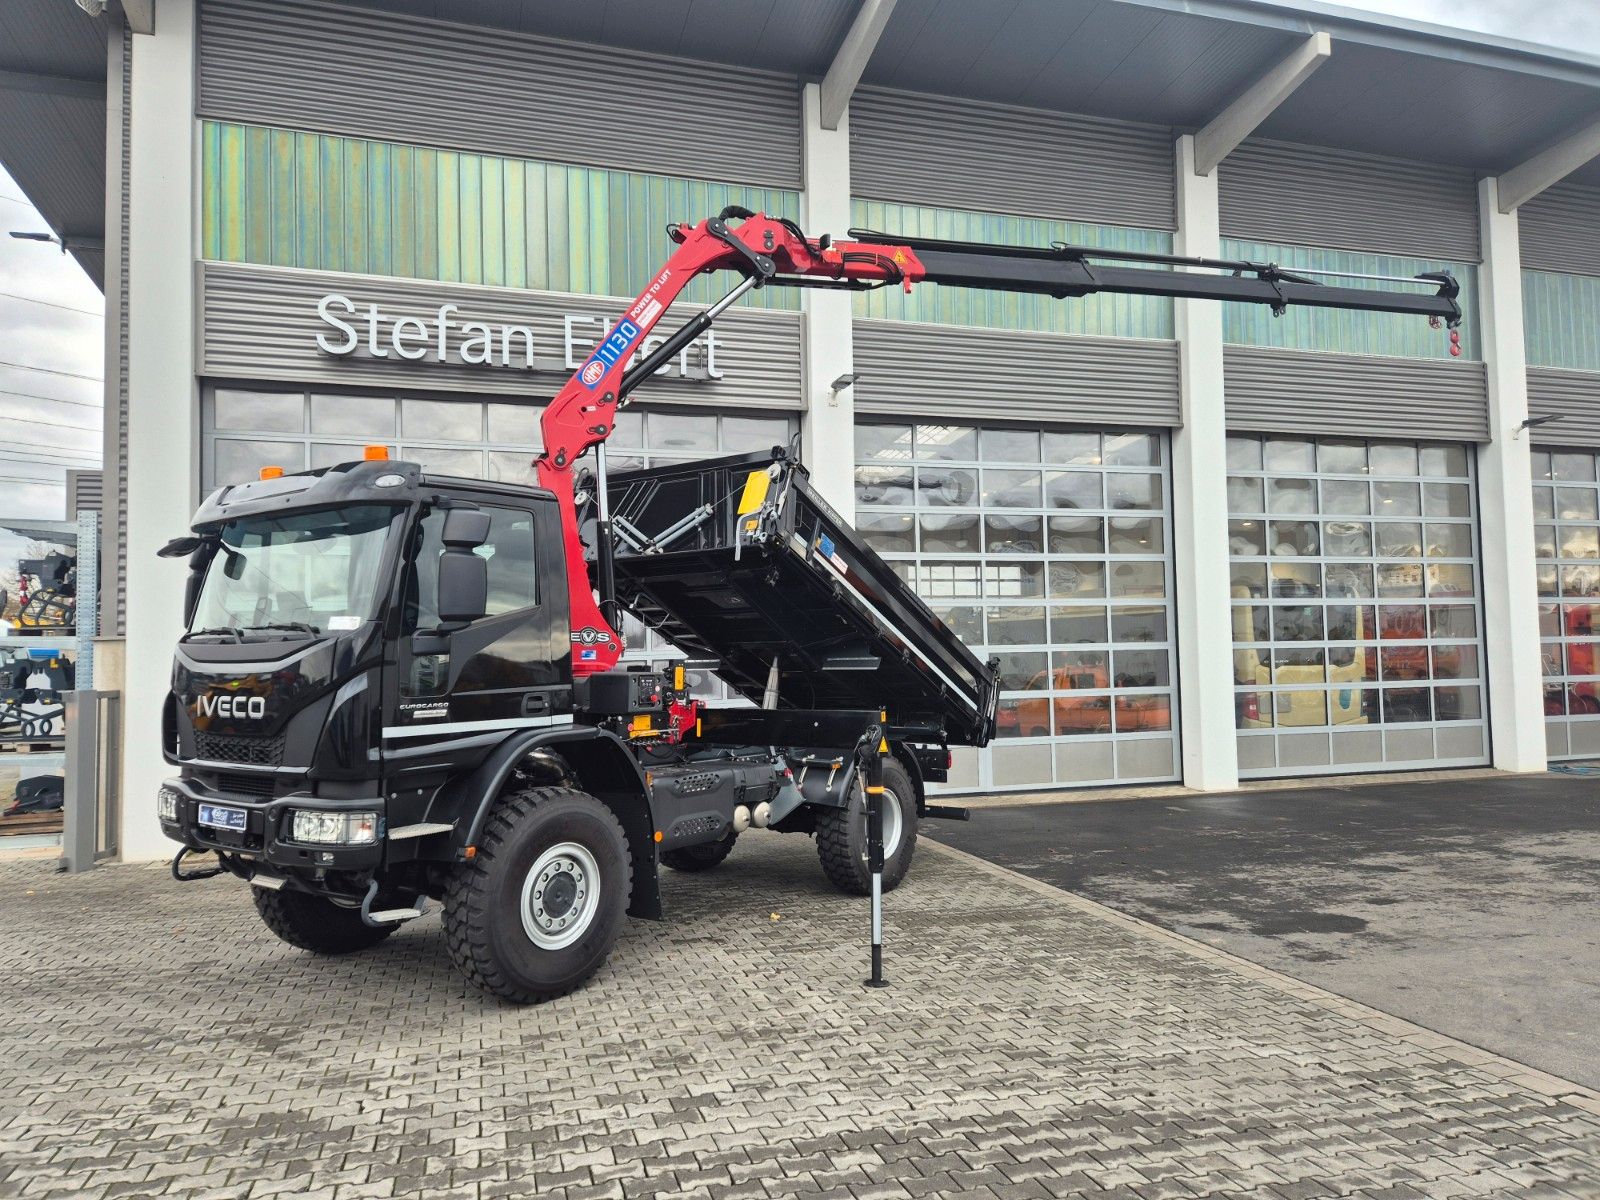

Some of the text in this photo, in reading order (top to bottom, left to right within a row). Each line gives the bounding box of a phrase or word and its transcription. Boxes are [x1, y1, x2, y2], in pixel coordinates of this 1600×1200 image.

[630, 293, 652, 318] POWER
[649, 283, 660, 294] TO
[658, 269, 672, 285] LIFT
[316, 294, 535, 368] Stefan
[600, 321, 637, 362] 1130
[584, 363, 603, 383] HMF
[197, 694, 265, 719] IVECO
[399, 702, 449, 710] EUROCARGO
